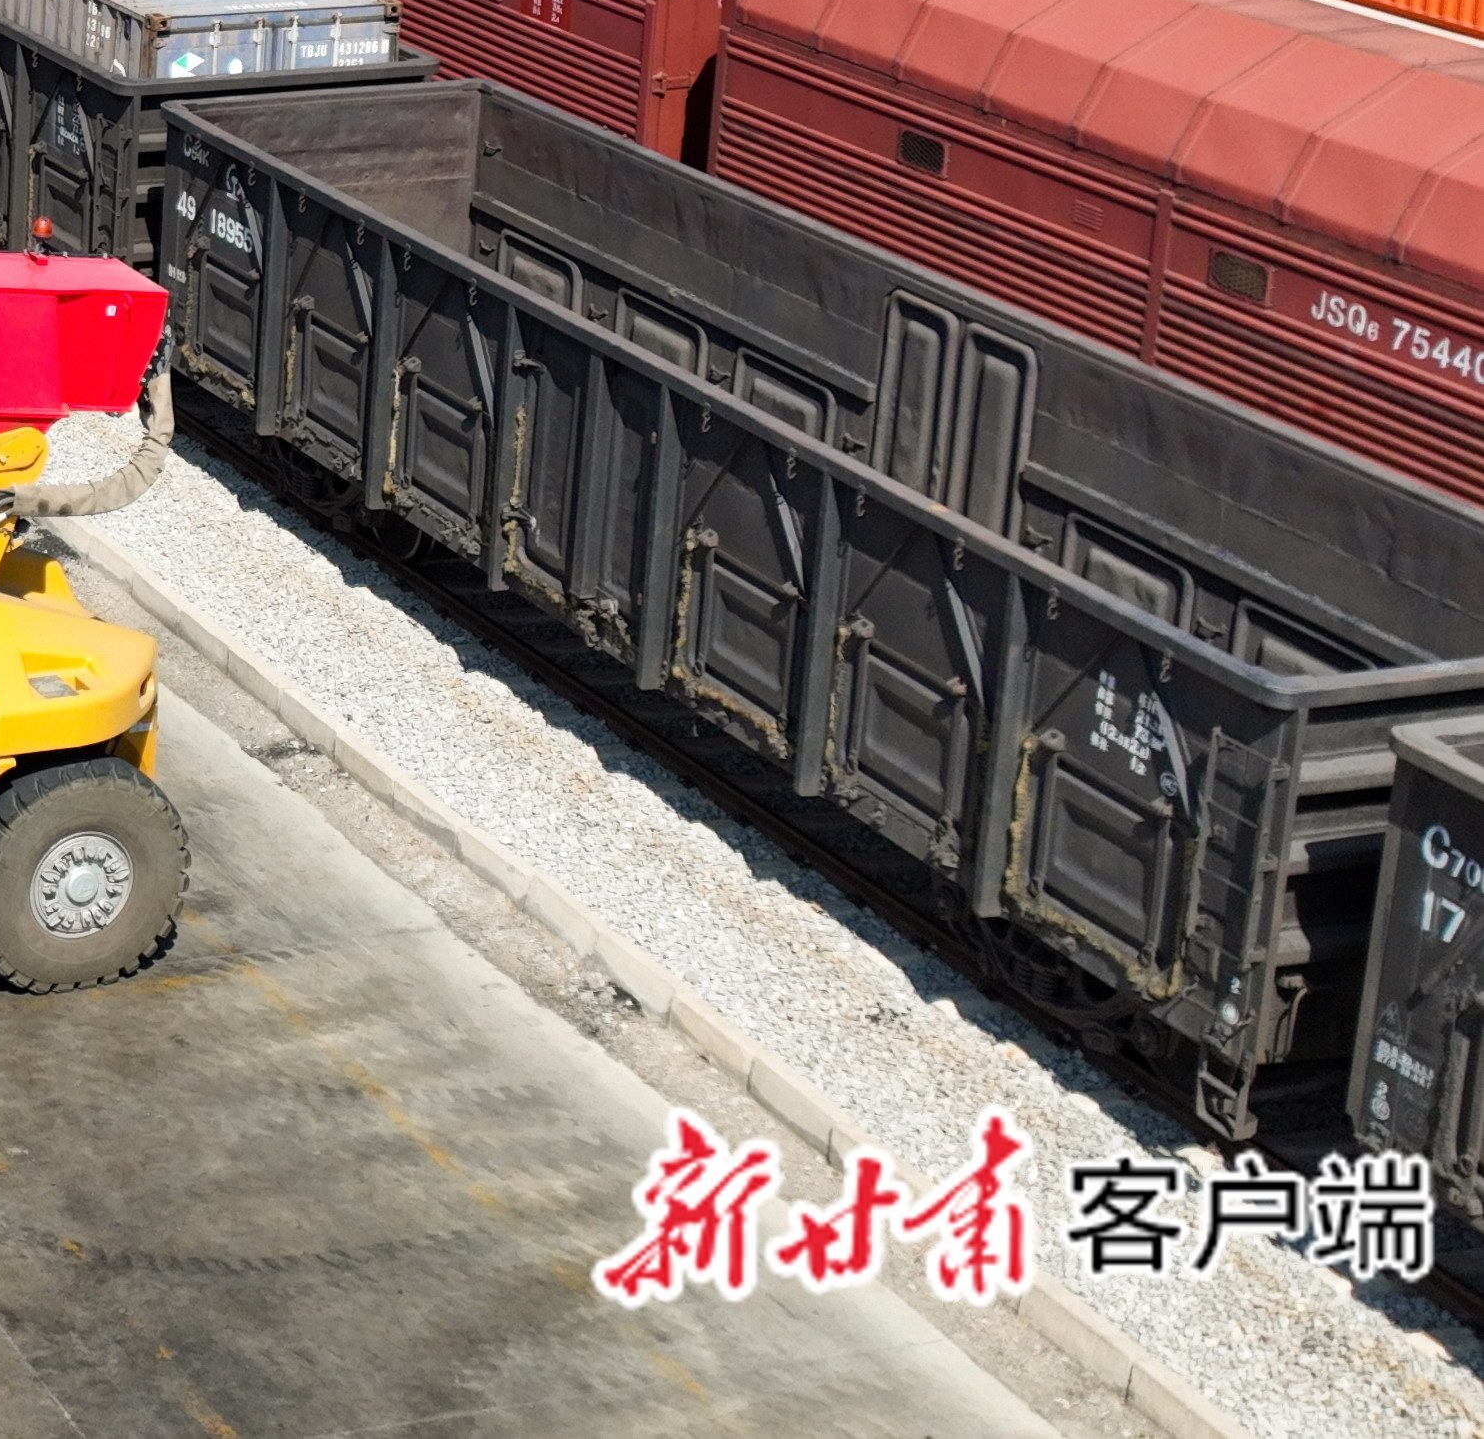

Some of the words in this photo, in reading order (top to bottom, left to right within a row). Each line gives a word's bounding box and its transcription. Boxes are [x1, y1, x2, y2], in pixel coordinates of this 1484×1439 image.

[301, 44, 328, 59] TBJU
[176, 190, 196, 220] 49
[1420, 823, 1484, 895] C70
[1420, 891, 1466, 944] 17
